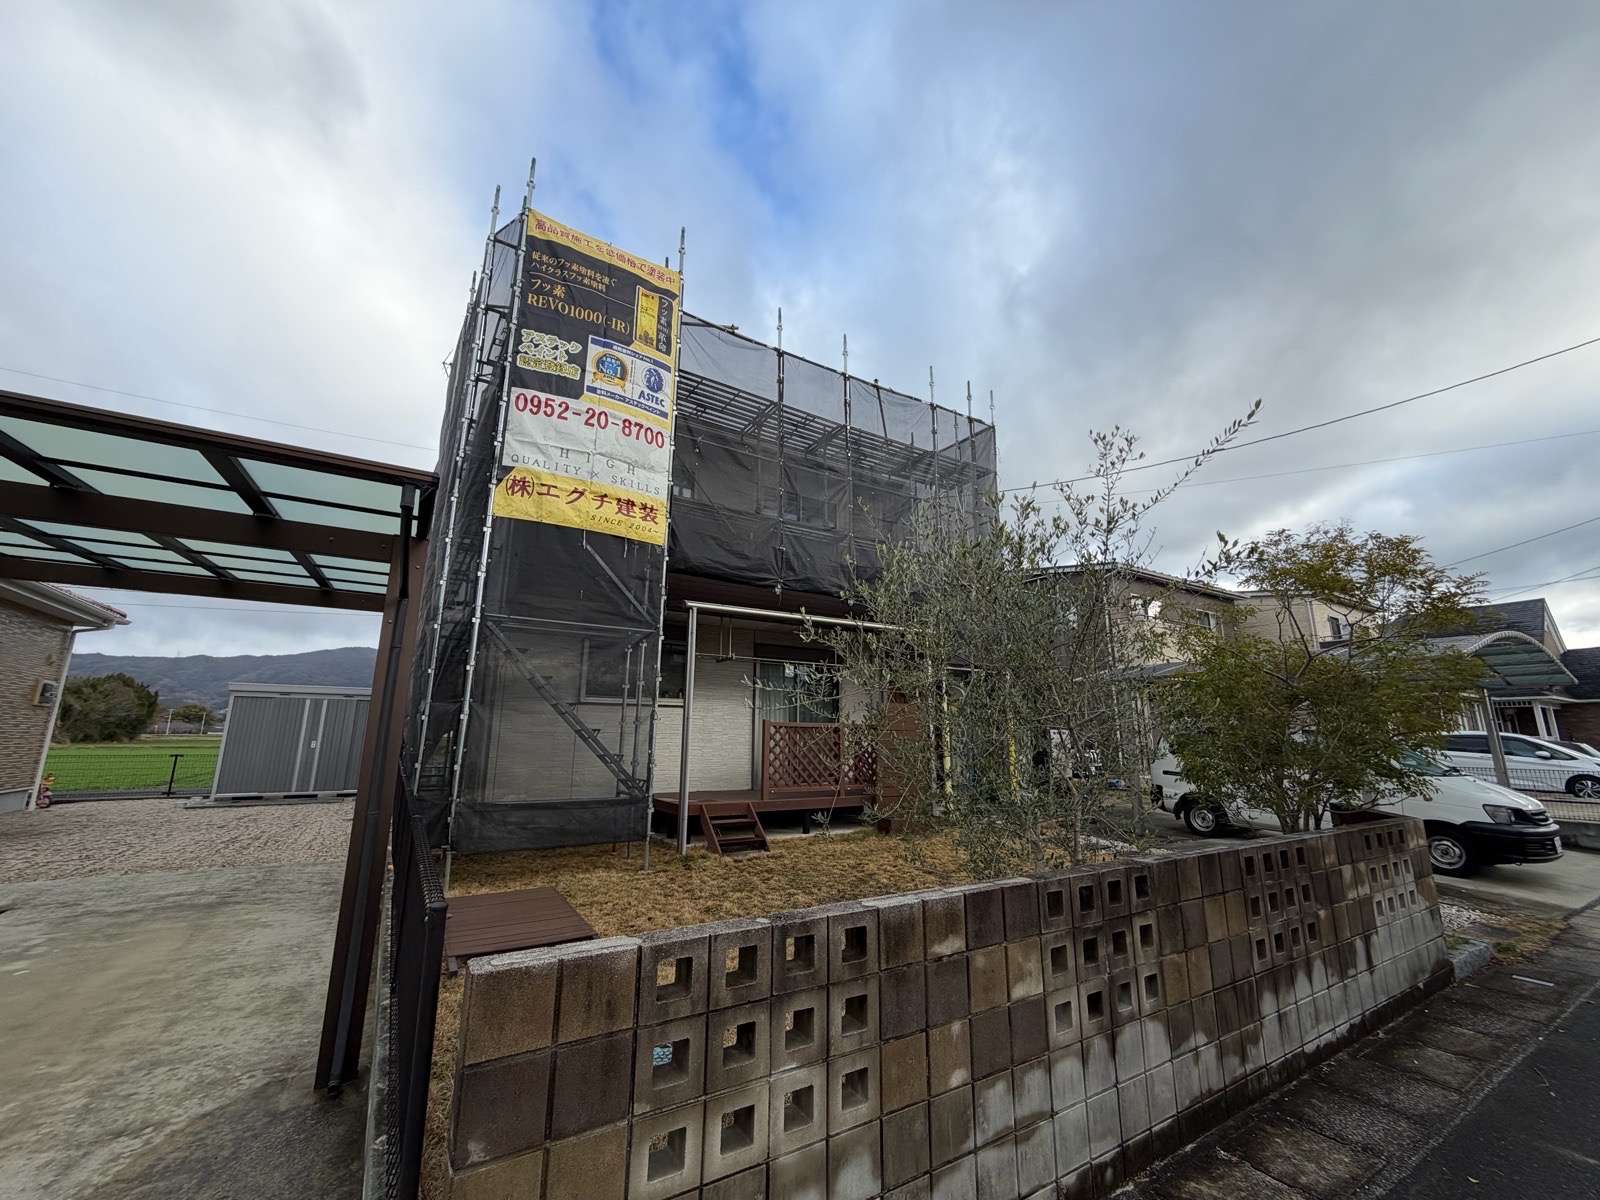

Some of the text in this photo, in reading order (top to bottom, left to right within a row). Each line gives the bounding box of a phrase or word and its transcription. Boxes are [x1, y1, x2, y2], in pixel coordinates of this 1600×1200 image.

[527, 293, 630, 335] REVO1000(-IR)
[638, 390, 665, 408] ASTEC
[514, 392, 665, 449] 0952-20-8700
[511, 453, 582, 476] QUALITY
[611, 474, 661, 496] SKILLS
